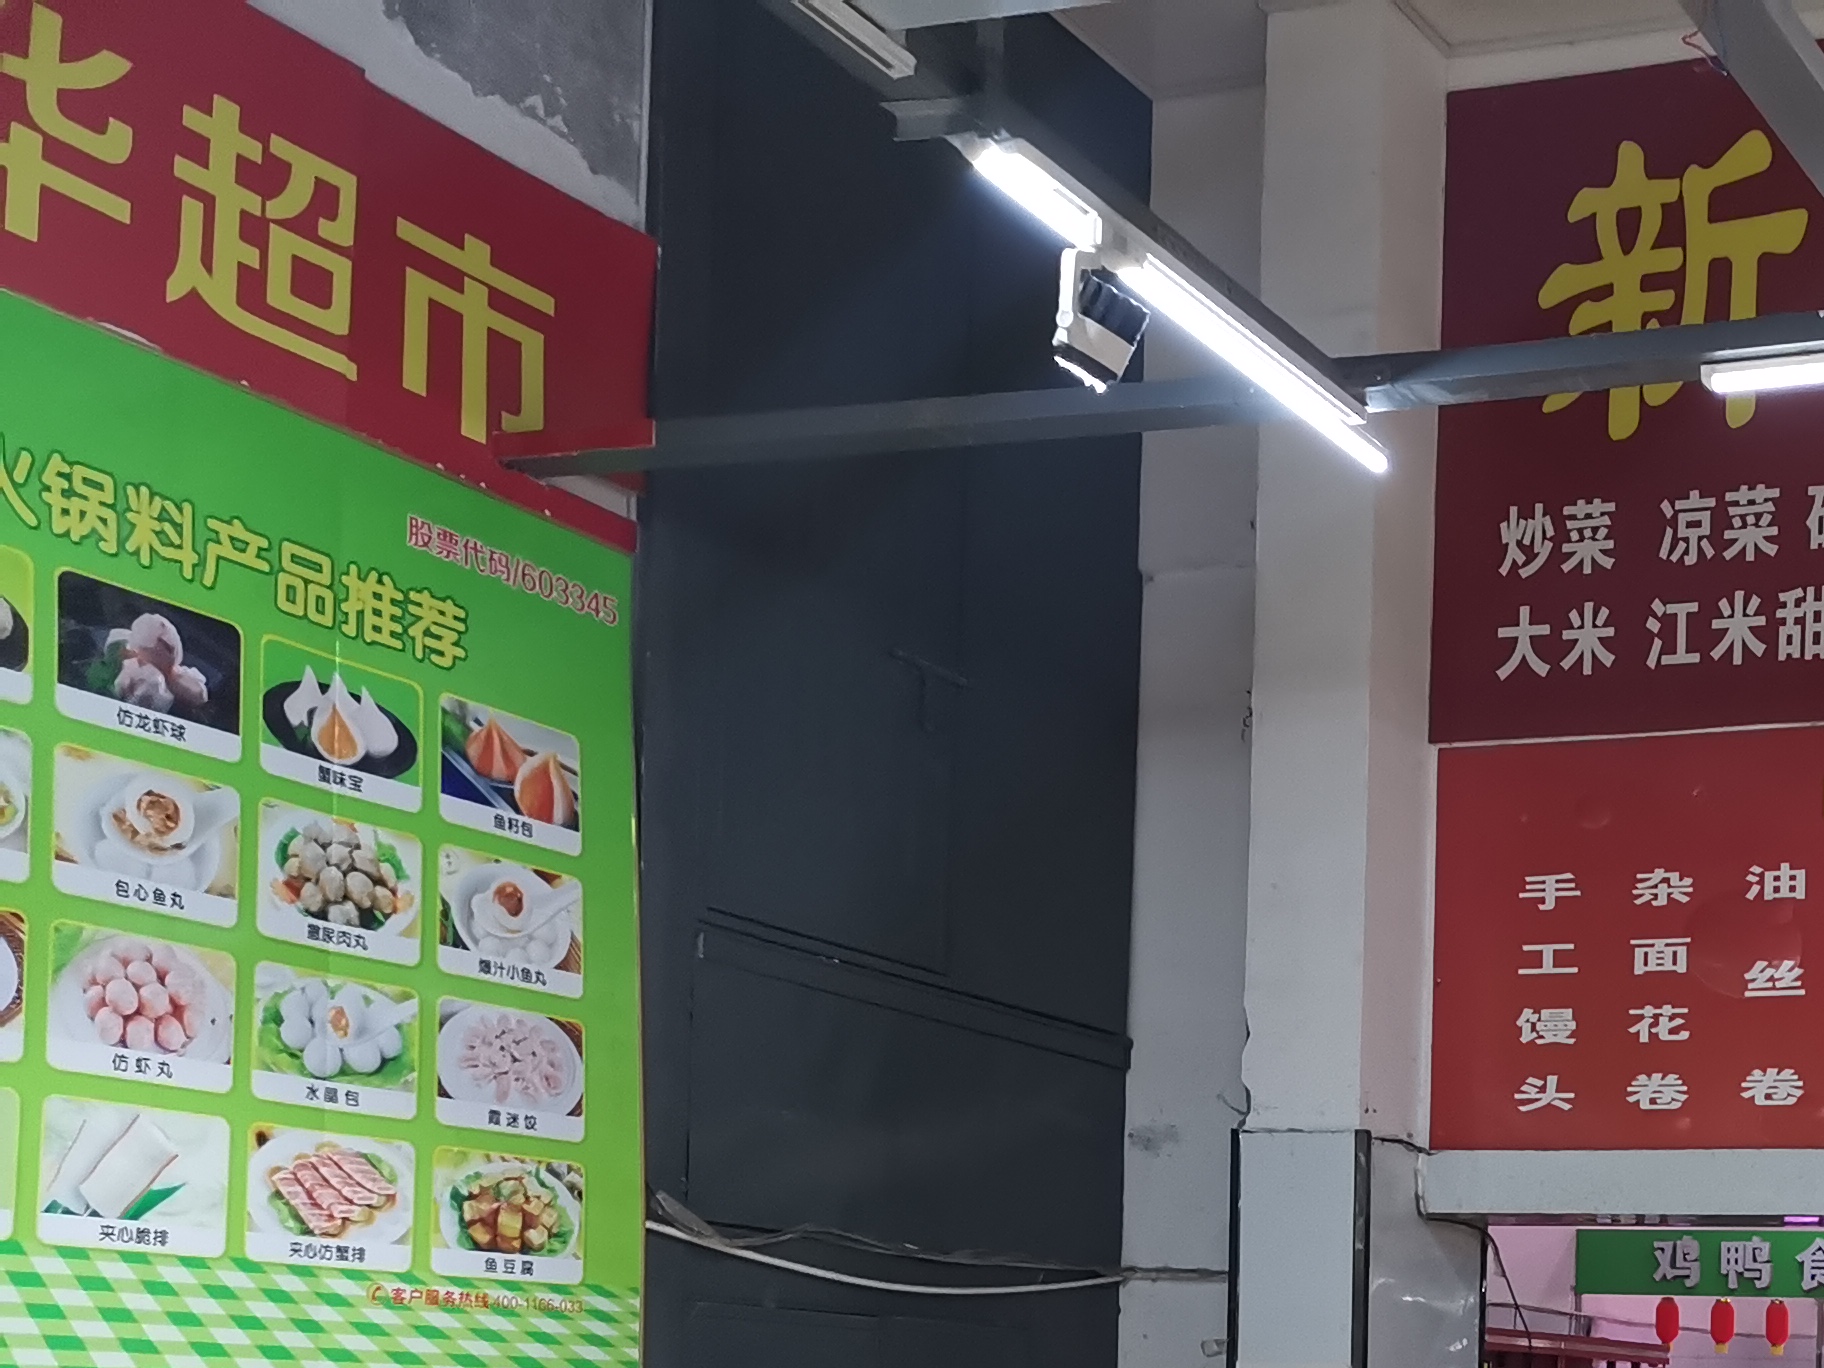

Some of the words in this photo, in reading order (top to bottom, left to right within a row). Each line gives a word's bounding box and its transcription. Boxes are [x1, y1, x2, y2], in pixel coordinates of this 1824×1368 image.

[1497, 498, 1617, 579] 炒菜
[1658, 484, 1782, 566] 凉菜
[408, 515, 619, 627] 股票代码/603345
[1496, 601, 1615, 682] 大米
[116, 706, 188, 743] 仿龙虾球
[493, 813, 533, 838] 鱼籽包
[114, 877, 186, 911] 包心鱼丸
[1514, 872, 1581, 1112] 手工馒头
[1626, 867, 1694, 1111] 杂面花卷
[1740, 862, 1808, 1106] 油丝卷
[112, 1053, 175, 1080] 仿虾丸
[304, 1084, 361, 1107] 水晶包
[99, 1224, 170, 1248] 夹心脆排
[484, 1256, 535, 1277] 鱼豆腐
[390, 1287, 490, 1310] 客户服务热线
